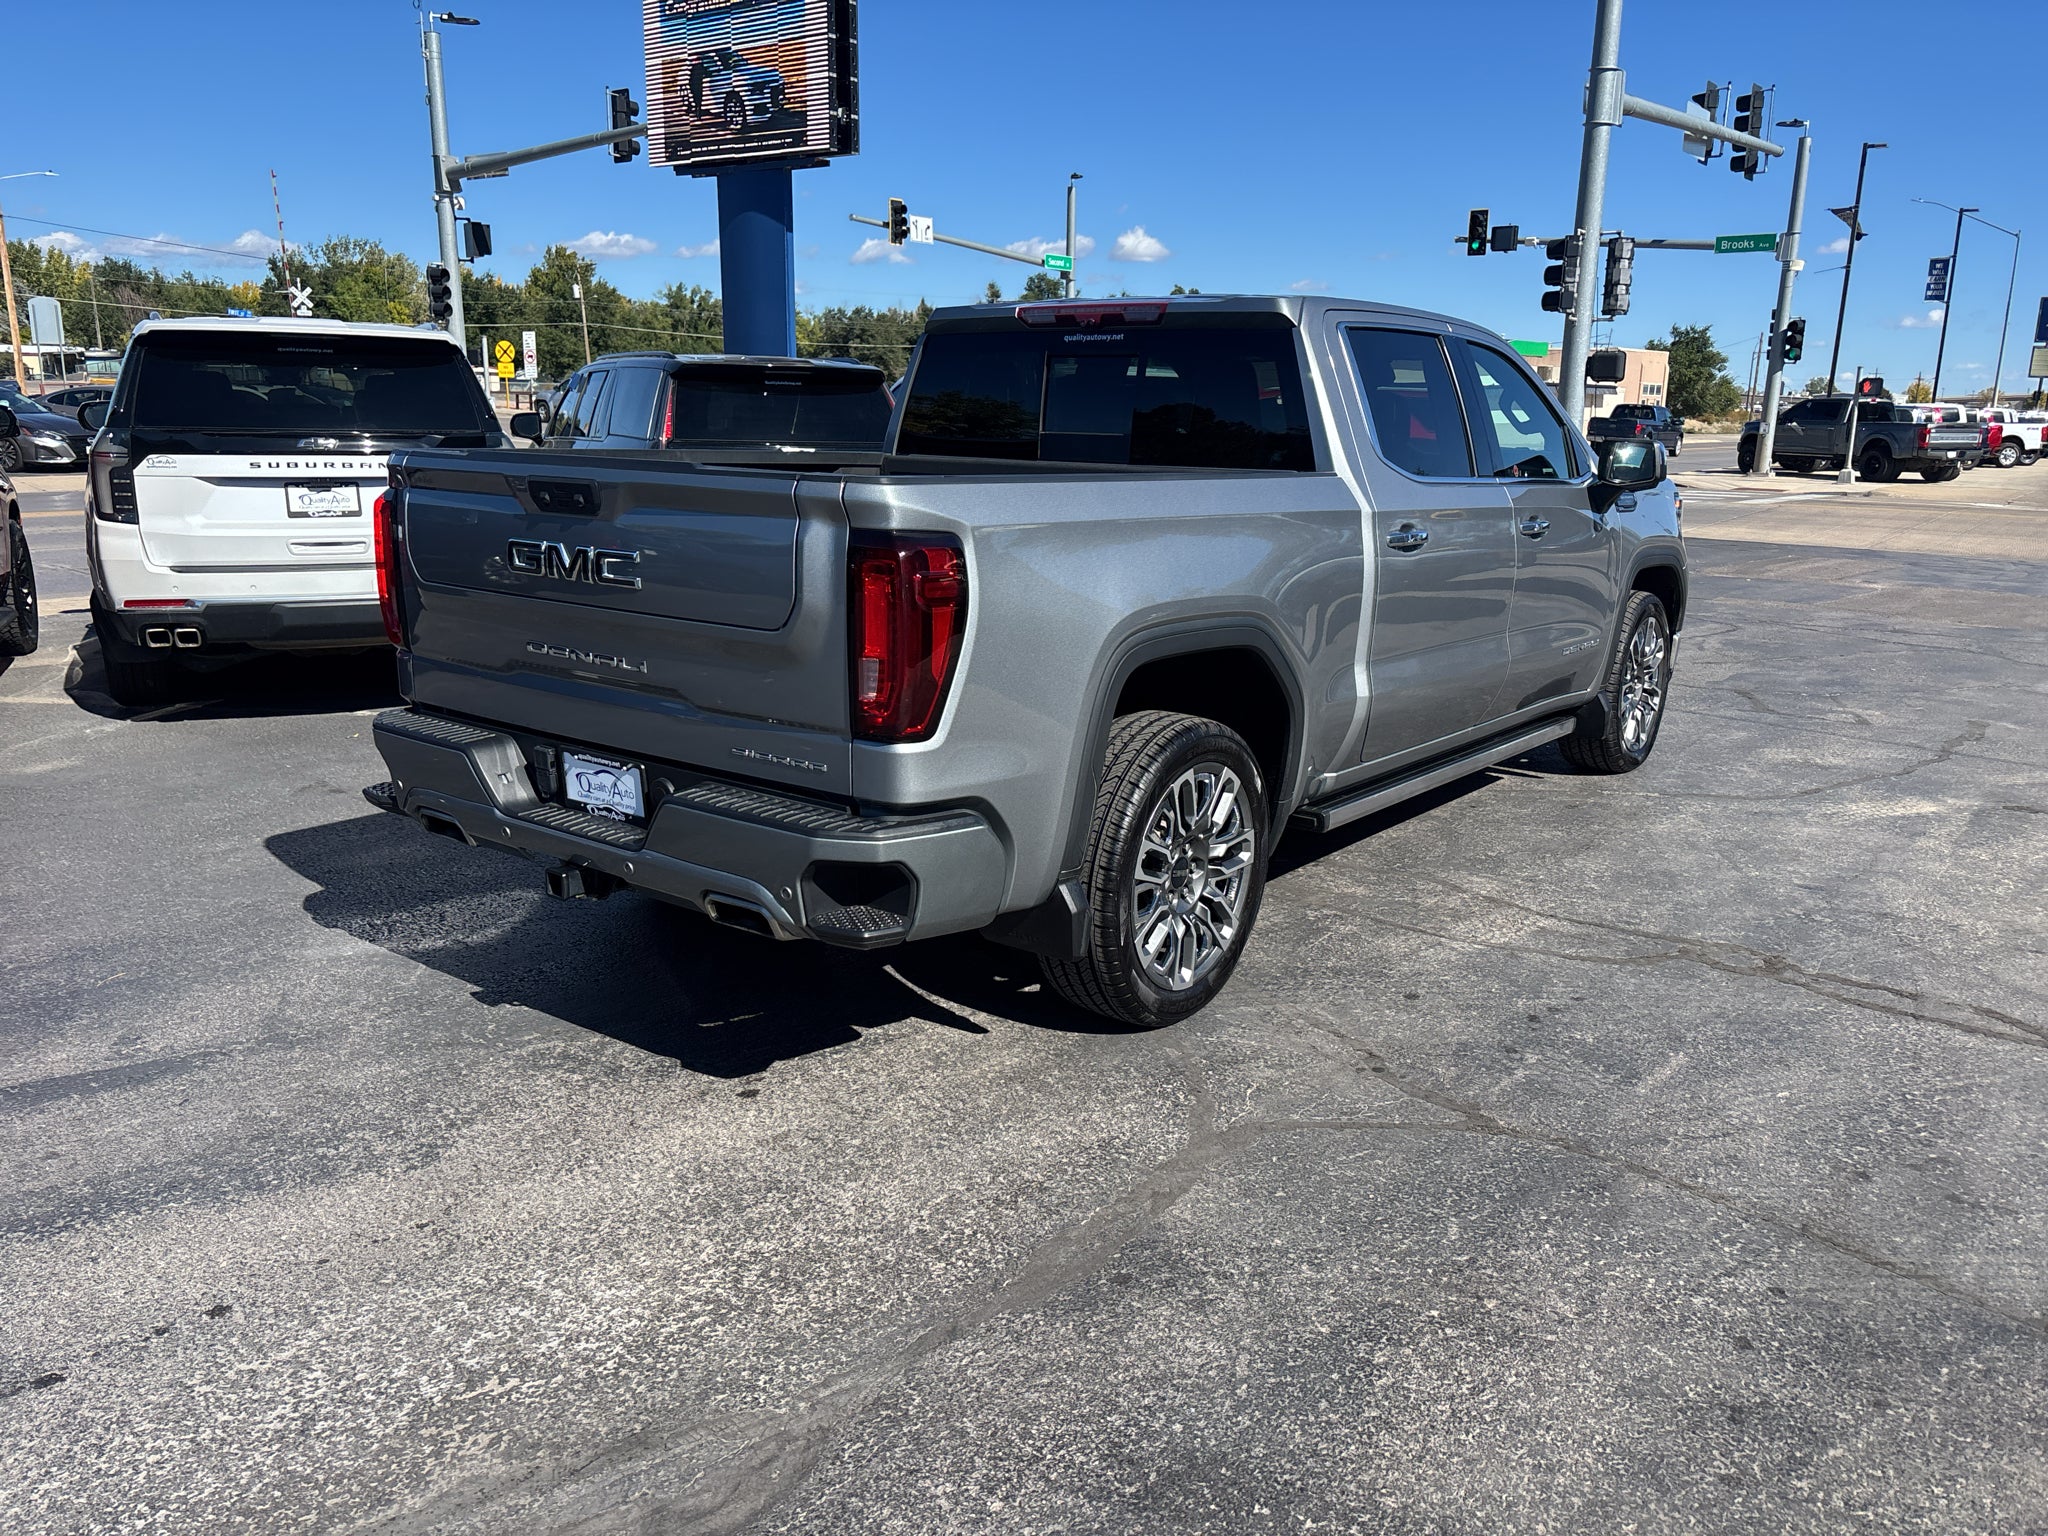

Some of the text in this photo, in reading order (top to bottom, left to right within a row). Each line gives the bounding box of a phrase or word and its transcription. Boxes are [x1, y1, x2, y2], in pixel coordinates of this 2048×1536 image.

[1720, 239, 1754, 250] Brooks
[1064, 334, 1124, 342] qualityautowy.net
[249, 461, 388, 469] SUBURBAN
[506, 538, 643, 590] GMC
[526, 640, 648, 674] DENALI
[732, 747, 828, 772] SIERRA
